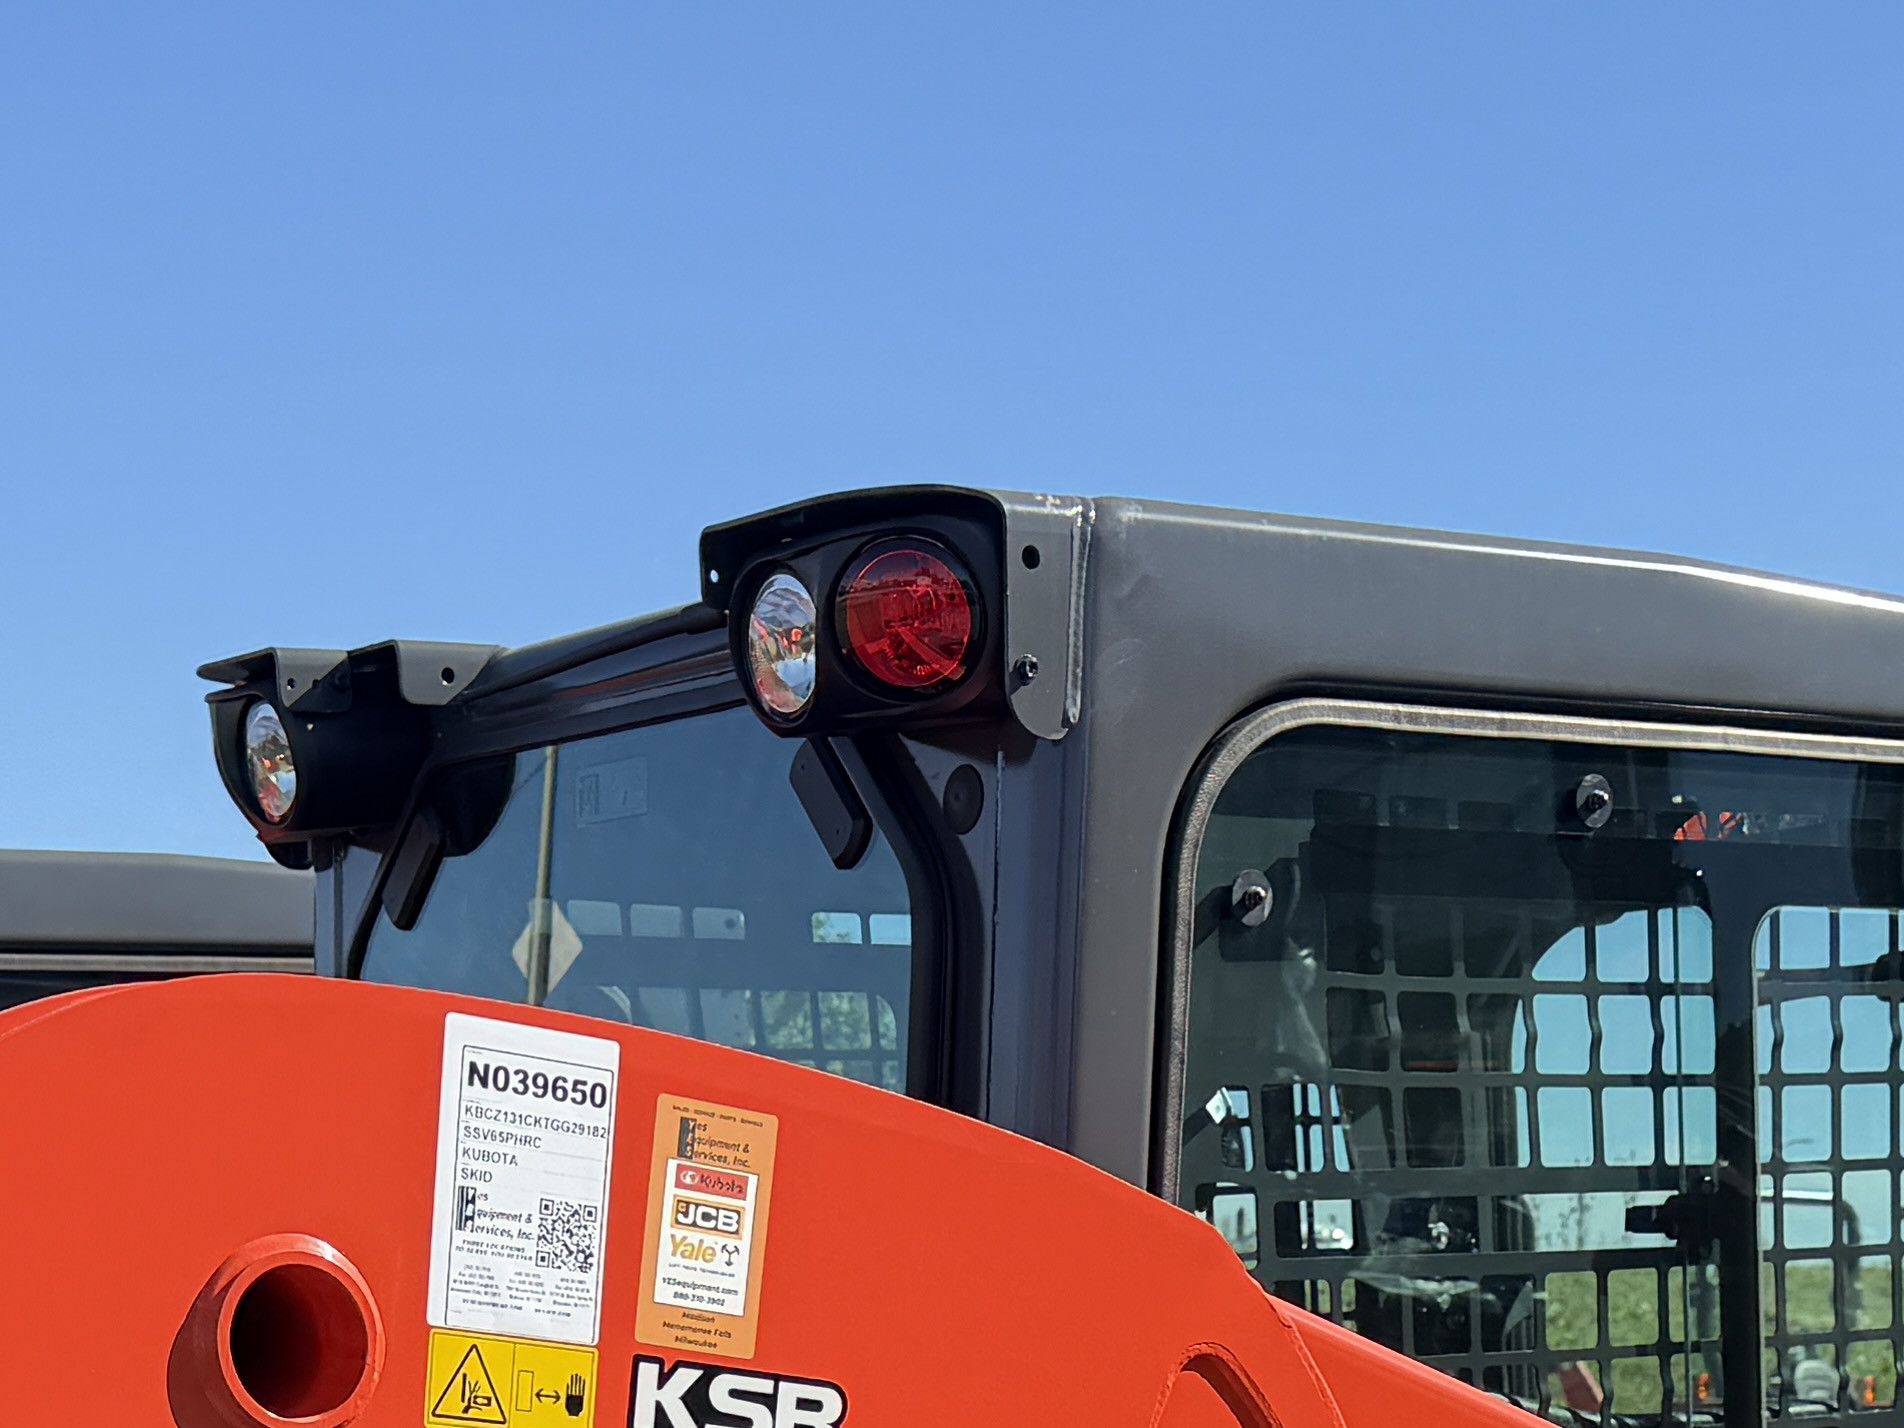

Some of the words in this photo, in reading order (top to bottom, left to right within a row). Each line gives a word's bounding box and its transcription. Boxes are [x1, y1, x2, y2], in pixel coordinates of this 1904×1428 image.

[467, 1061, 607, 1108] N039650
[462, 1147, 518, 1167] KUBOTA
[742, 1144, 750, 1154] &
[461, 1167, 493, 1183] SKID
[700, 1173, 744, 1194] Kubota
[677, 1202, 739, 1232] JCB
[670, 1234, 717, 1263] Yale
